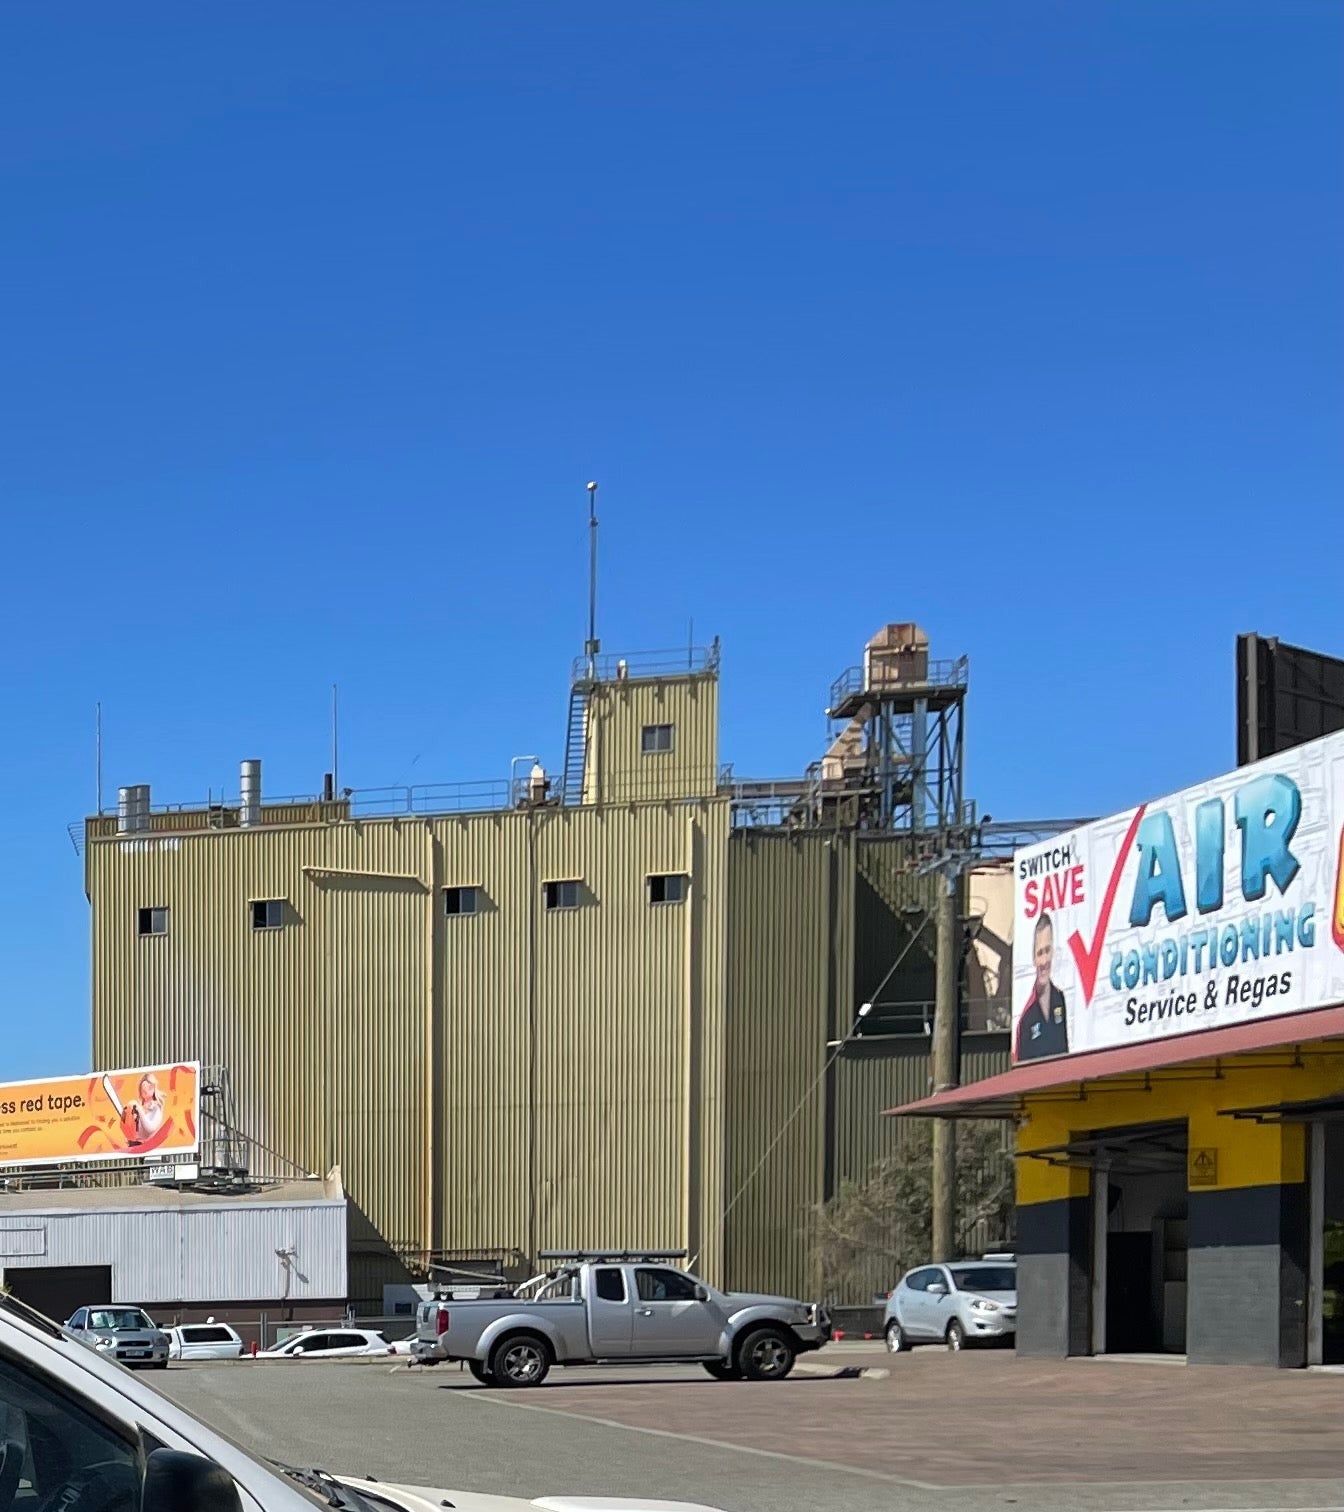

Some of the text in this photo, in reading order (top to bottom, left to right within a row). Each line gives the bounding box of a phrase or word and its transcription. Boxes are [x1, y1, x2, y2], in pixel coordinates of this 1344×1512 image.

[1020, 844, 1071, 879] SWITCH
[1129, 773, 1302, 927] AIR
[1024, 864, 1084, 918] SAVE
[1109, 902, 1316, 990] CONDITIONING
[1125, 971, 1292, 1026] Service & Regas
[20, 1094, 43, 1112] red
[48, 1094, 85, 1113] tape.
